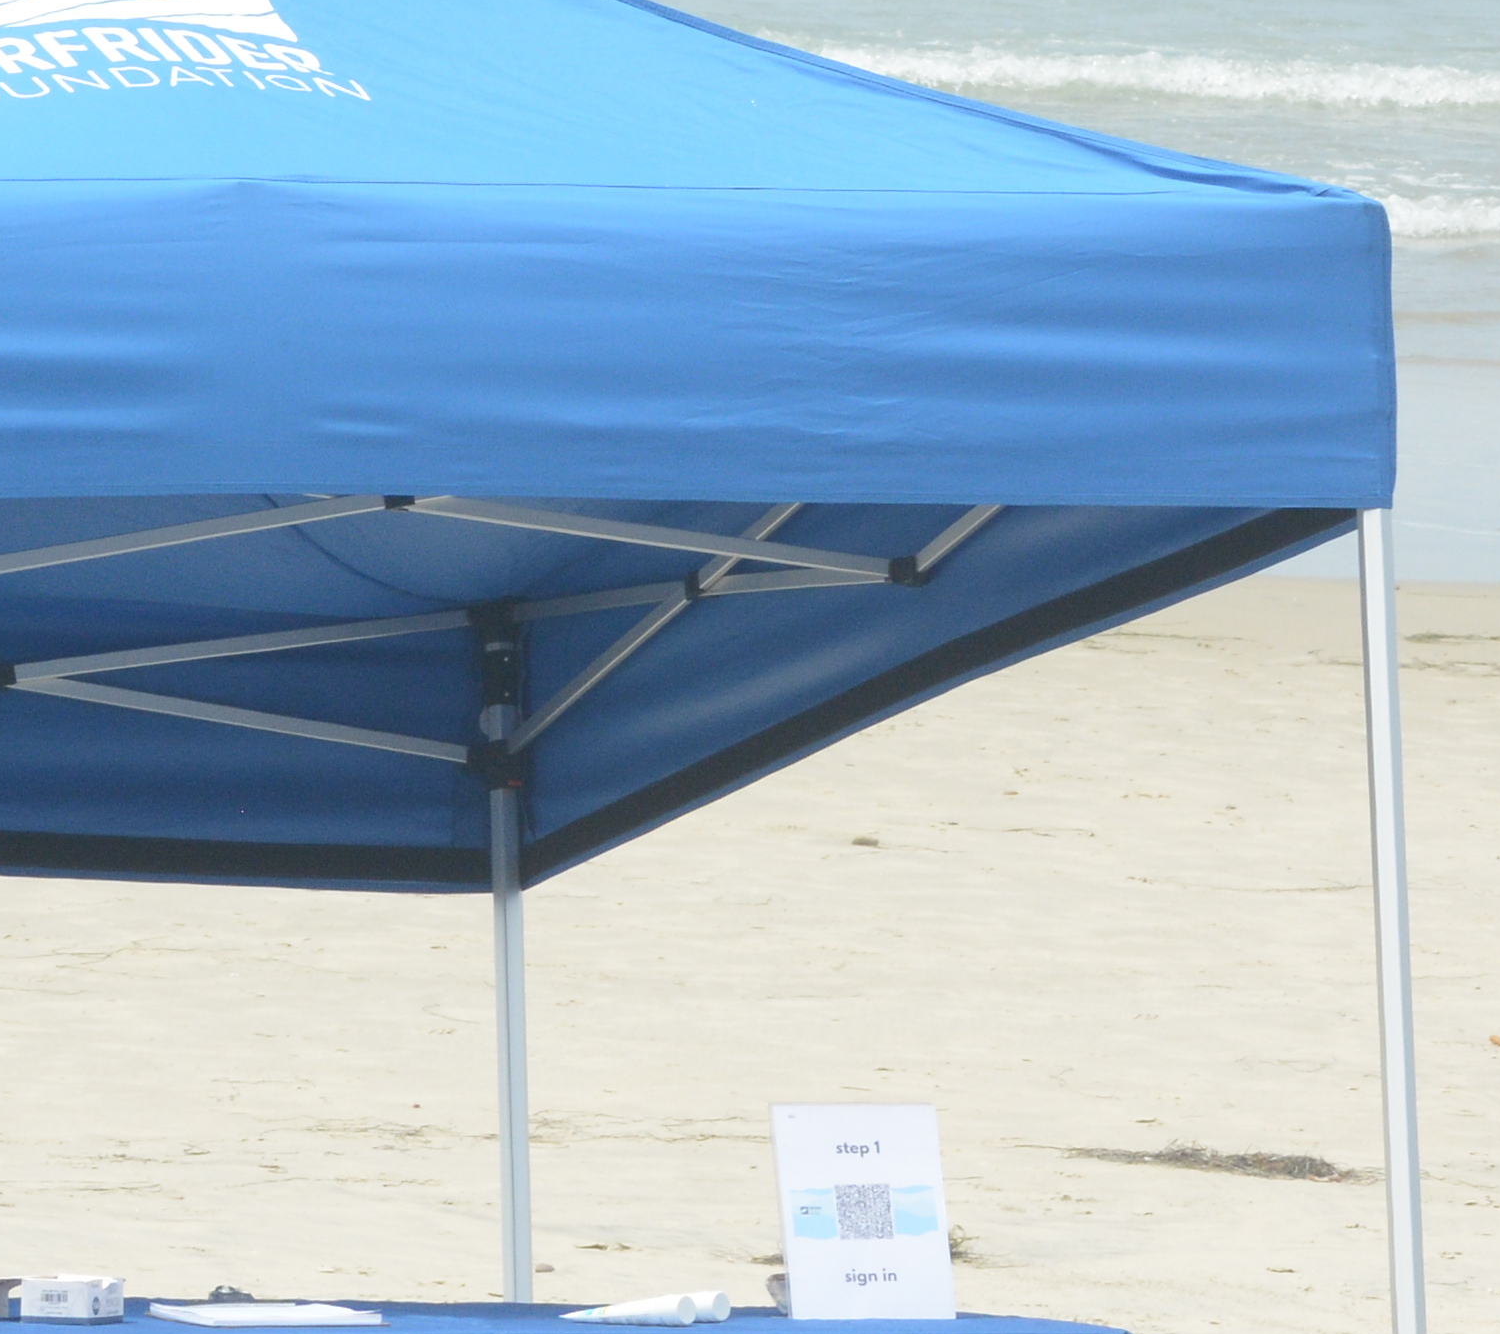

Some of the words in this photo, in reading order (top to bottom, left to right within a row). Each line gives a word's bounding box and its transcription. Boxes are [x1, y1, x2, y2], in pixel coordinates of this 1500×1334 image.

[836, 1142, 870, 1158] step
[874, 1140, 881, 1154] 1
[845, 1268, 878, 1286] sign
[882, 1267, 898, 1282] in
